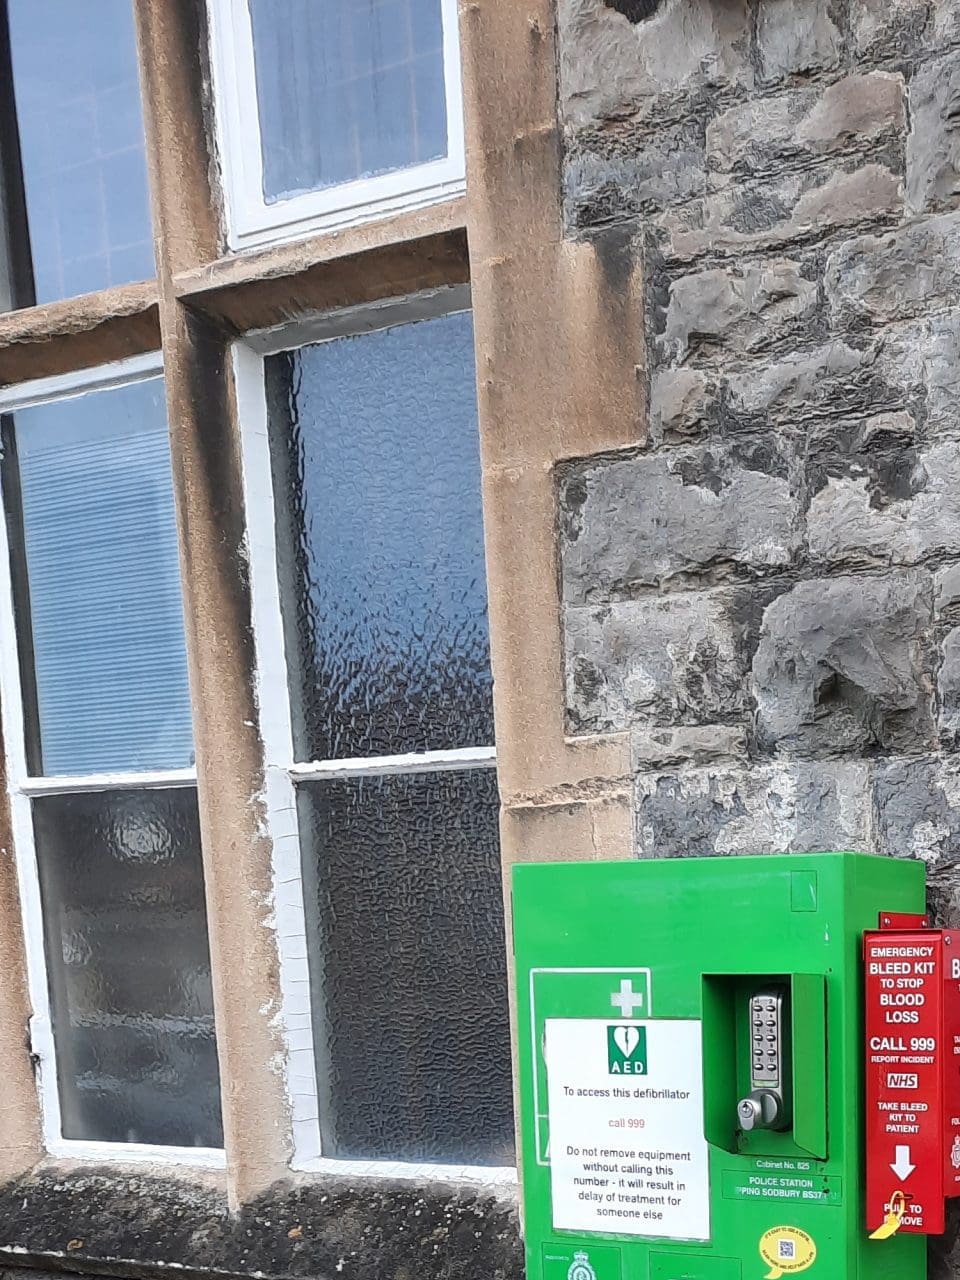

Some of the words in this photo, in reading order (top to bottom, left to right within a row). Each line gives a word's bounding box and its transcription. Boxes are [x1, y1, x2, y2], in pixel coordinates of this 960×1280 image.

[871, 947, 934, 957] EMERGENCY
[870, 962, 911, 974] BLEED
[914, 962, 935, 974] KIT
[880, 978, 895, 989] TO
[897, 978, 924, 988] STOP
[880, 994, 925, 1006] BLOOD
[885, 1011, 919, 1023] LOSS
[870, 1037, 907, 1051] CALL
[910, 1038, 935, 1051] 999
[871, 1055, 900, 1063] REPORT
[901, 1056, 934, 1064] INCIDENT
[611, 1060, 644, 1074] AED
[888, 1074, 917, 1088] NHS
[563, 1086, 574, 1096] To
[577, 1089, 610, 1098] access
[612, 1088, 631, 1098] this
[633, 1088, 691, 1100] defibrillator
[877, 1102, 899, 1111] TAKE
[900, 1102, 928, 1111] BLEED
[608, 1119, 626, 1128] call
[627, 1119, 645, 1128] 999
[889, 1113, 903, 1122] KIT
[905, 1114, 916, 1122] TO
[886, 1124, 919, 1133] PATIENT
[566, 1145, 580, 1156] Do
[582, 1146, 598, 1157] not
[600, 1149, 636, 1159] remove
[638, 1151, 691, 1163] equipment
[583, 1162, 619, 1173] without
[621, 1163, 653, 1177] calling
[655, 1164, 674, 1175] this
[756, 1160, 783, 1169] Cabinet
[784, 1161, 795, 1170] No.
[797, 1162, 810, 1170] 825
[573, 1176, 609, 1187] number
[618, 1177, 625, 1188] it
[627, 1178, 644, 1188] will
[646, 1180, 674, 1191] result
[677, 1181, 685, 1191] in
[749, 1177, 778, 1186] POLICE
[779, 1178, 813, 1188] STATION
[578, 1190, 604, 1204] delay
[605, 1191, 617, 1202] of
[618, 1193, 665, 1205] treatment
[667, 1196, 682, 1206] for
[762, 1188, 800, 1198] SODBURY
[802, 1190, 823, 1200] BS37
[596, 1207, 641, 1219] someone
[643, 1209, 663, 1220] else
[884, 1203, 908, 1213] PUL
[909, 1204, 922, 1213] TO
[884, 1215, 922, 1226] MOVE
